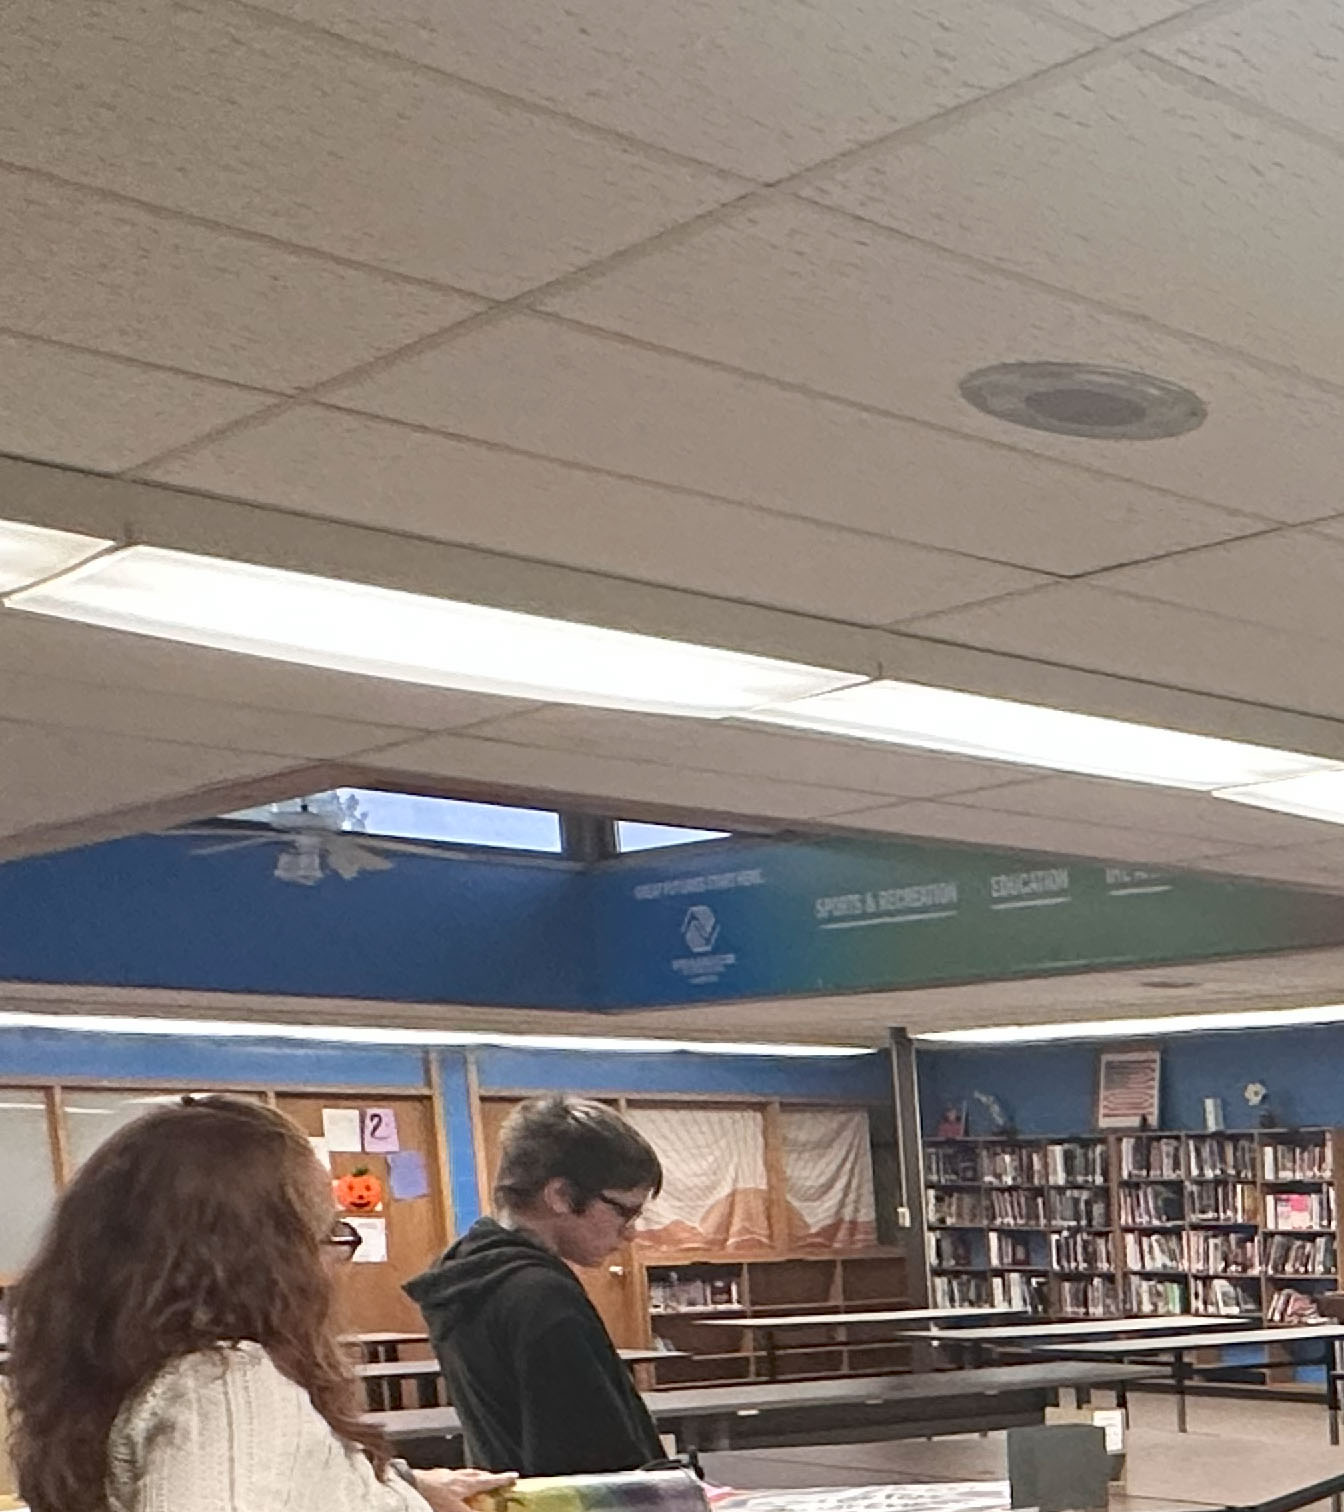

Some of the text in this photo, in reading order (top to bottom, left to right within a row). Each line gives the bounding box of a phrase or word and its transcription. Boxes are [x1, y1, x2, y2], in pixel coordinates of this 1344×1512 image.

[990, 868, 1069, 898] EDUCATION
[815, 882, 958, 919] SPORTS & RECREATION
[369, 1112, 393, 1140] 2
